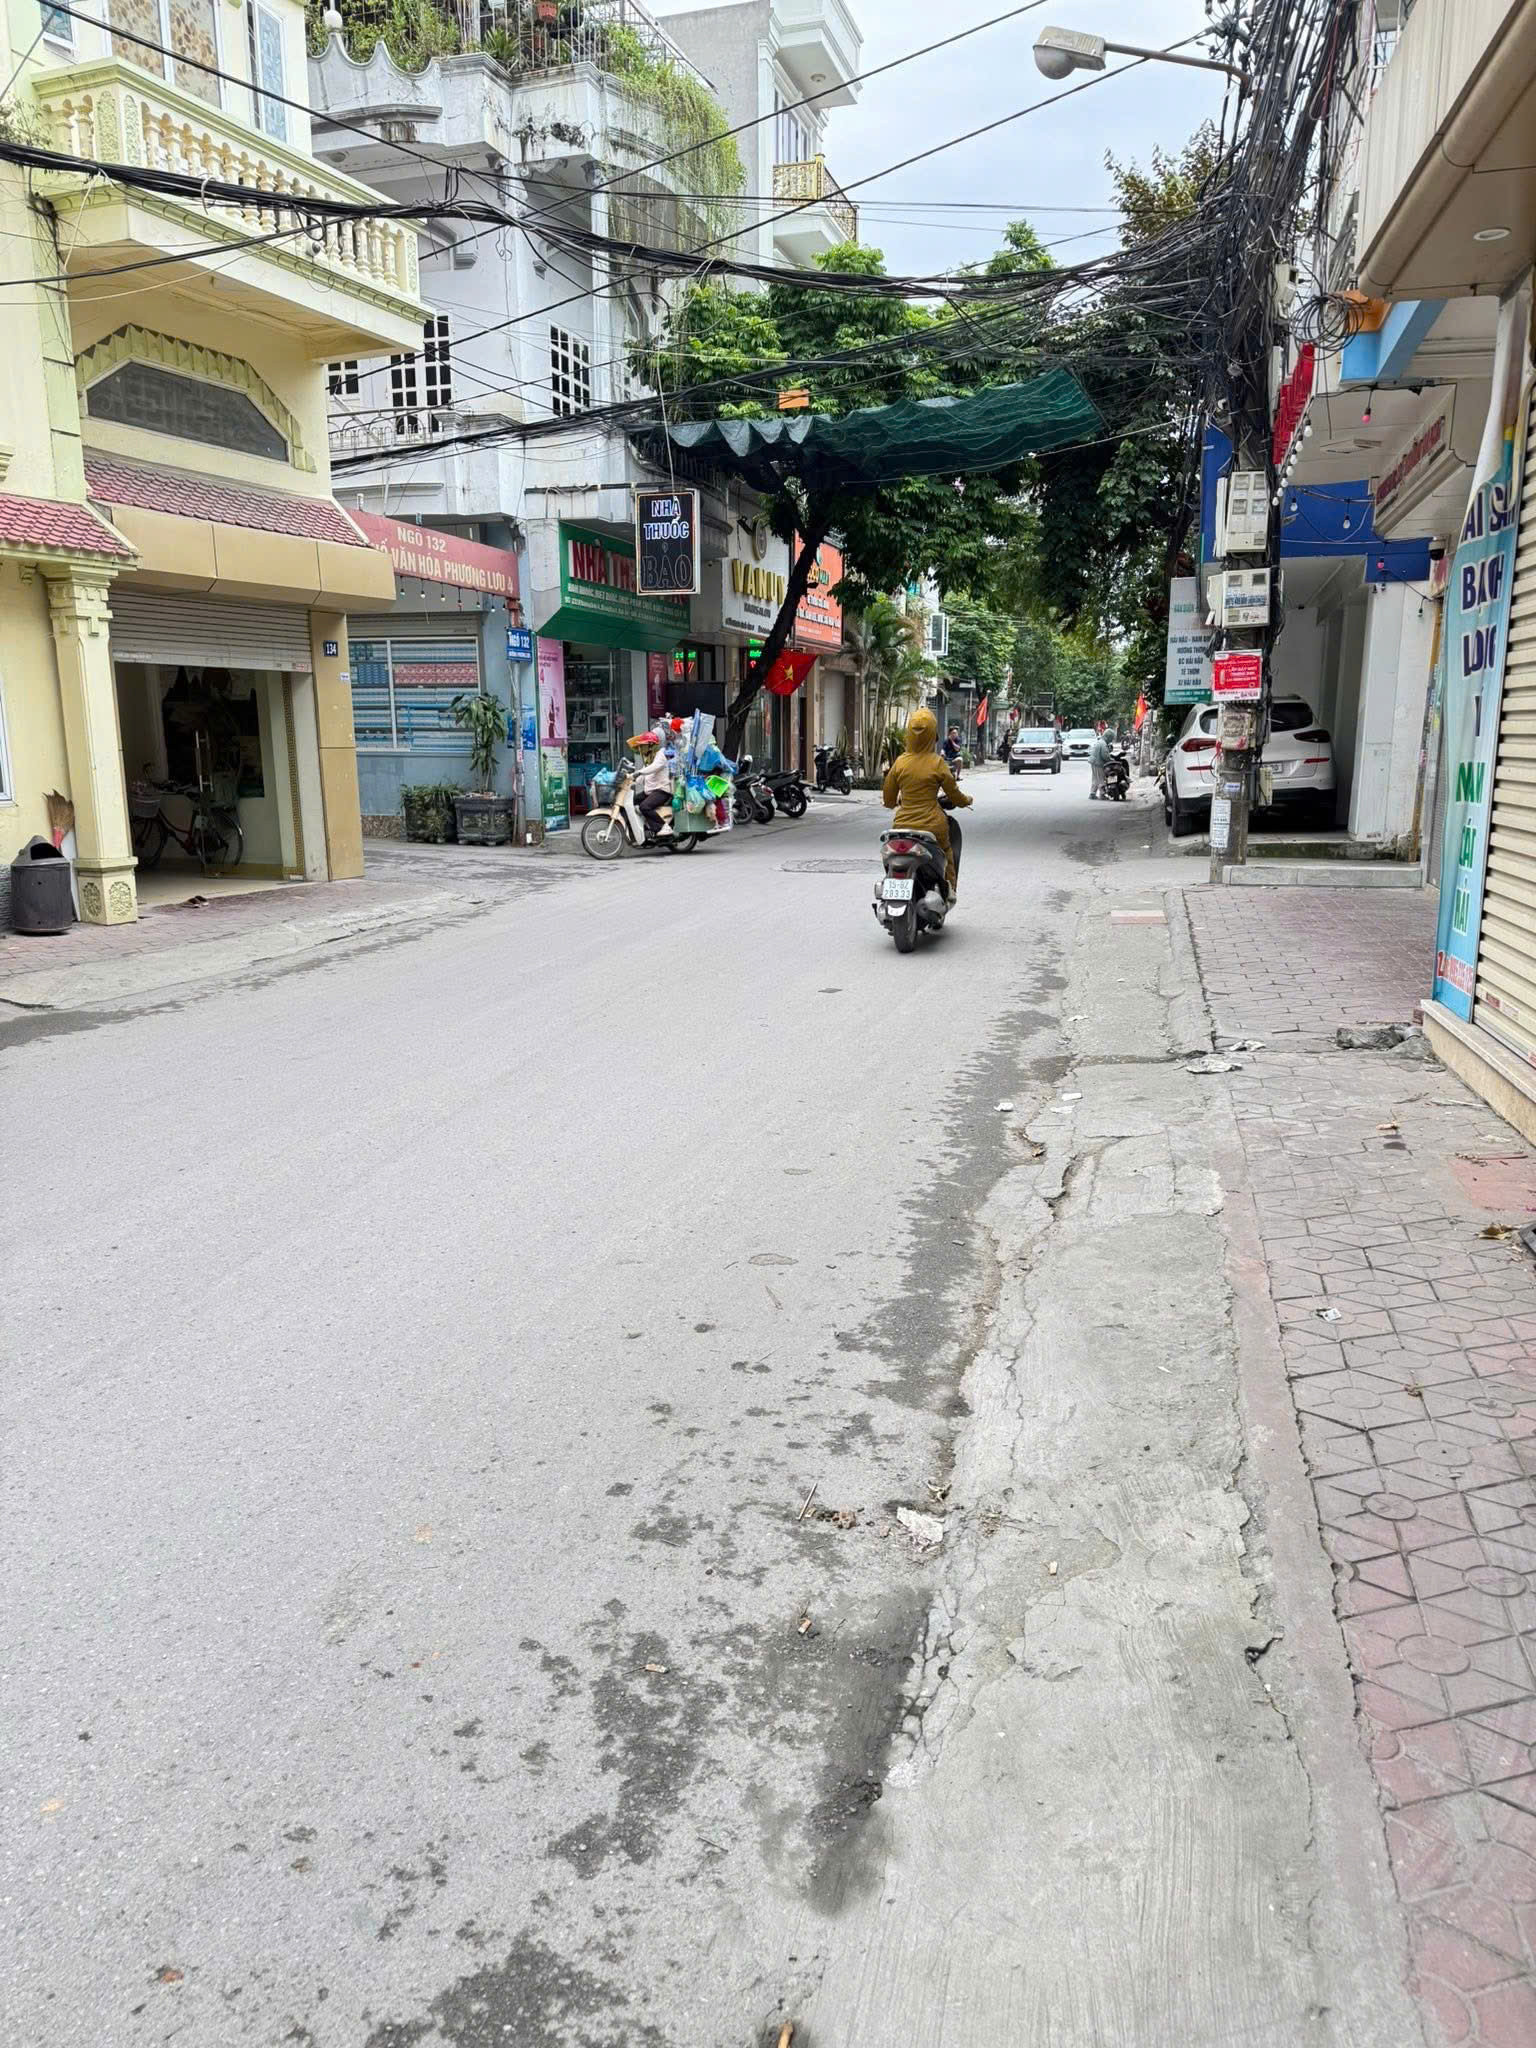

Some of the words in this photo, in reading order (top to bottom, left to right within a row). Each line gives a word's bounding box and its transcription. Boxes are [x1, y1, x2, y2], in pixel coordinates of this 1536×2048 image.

[652, 495, 681, 517] NHÀ
[643, 516, 690, 540] THUỐC
[426, 535, 446, 552] 132
[391, 546, 416, 571] VĂN
[418, 551, 440, 578] HÓA
[444, 559, 486, 589] PHƯƠNG
[487, 570, 506, 592] LƯU
[507, 576, 514, 594] 4
[520, 635, 530, 648] 132
